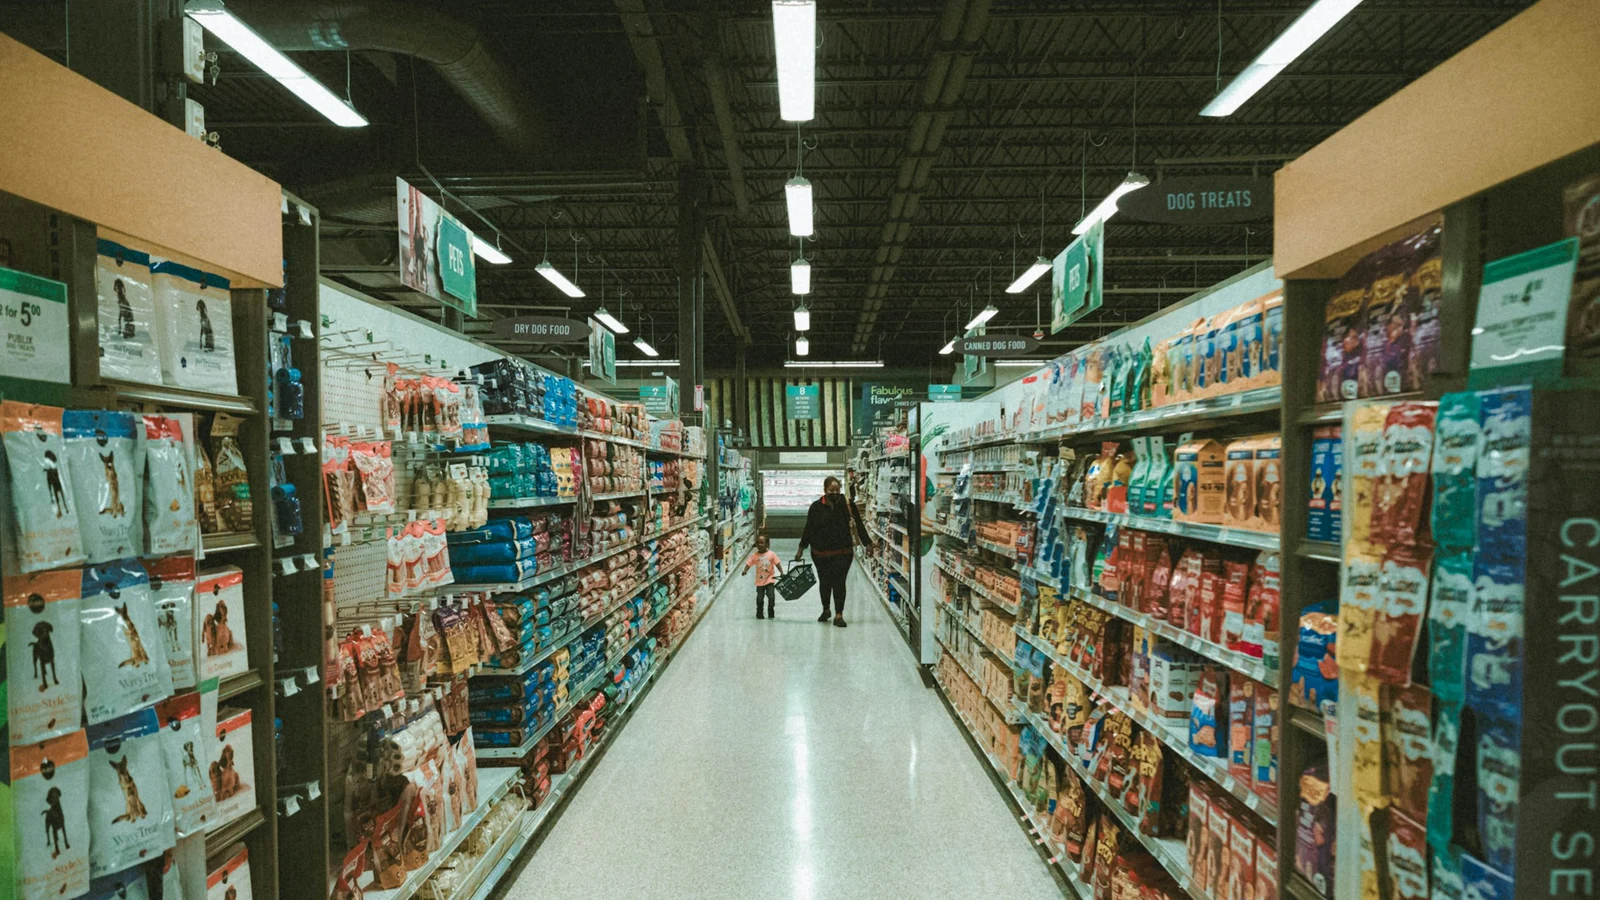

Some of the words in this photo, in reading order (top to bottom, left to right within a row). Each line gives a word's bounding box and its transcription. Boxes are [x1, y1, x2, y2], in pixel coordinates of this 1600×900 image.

[1167, 193, 1195, 210] DOG
[1200, 190, 1252, 208] TREATS
[448, 243, 464, 277] PETS
[5, 305, 18, 318] for
[514, 323, 530, 334] DRY
[531, 324, 547, 335] DOG
[549, 324, 570, 335] FOOD
[964, 341, 991, 351] CANNED
[992, 341, 1006, 350] DOG
[1008, 340, 1026, 350] FOOD
[799, 386, 806, 395] 8
[871, 385, 913, 396] Fabulous
[942, 385, 948, 393] 7
[1554, 517, 1600, 810] CARRYOUT
